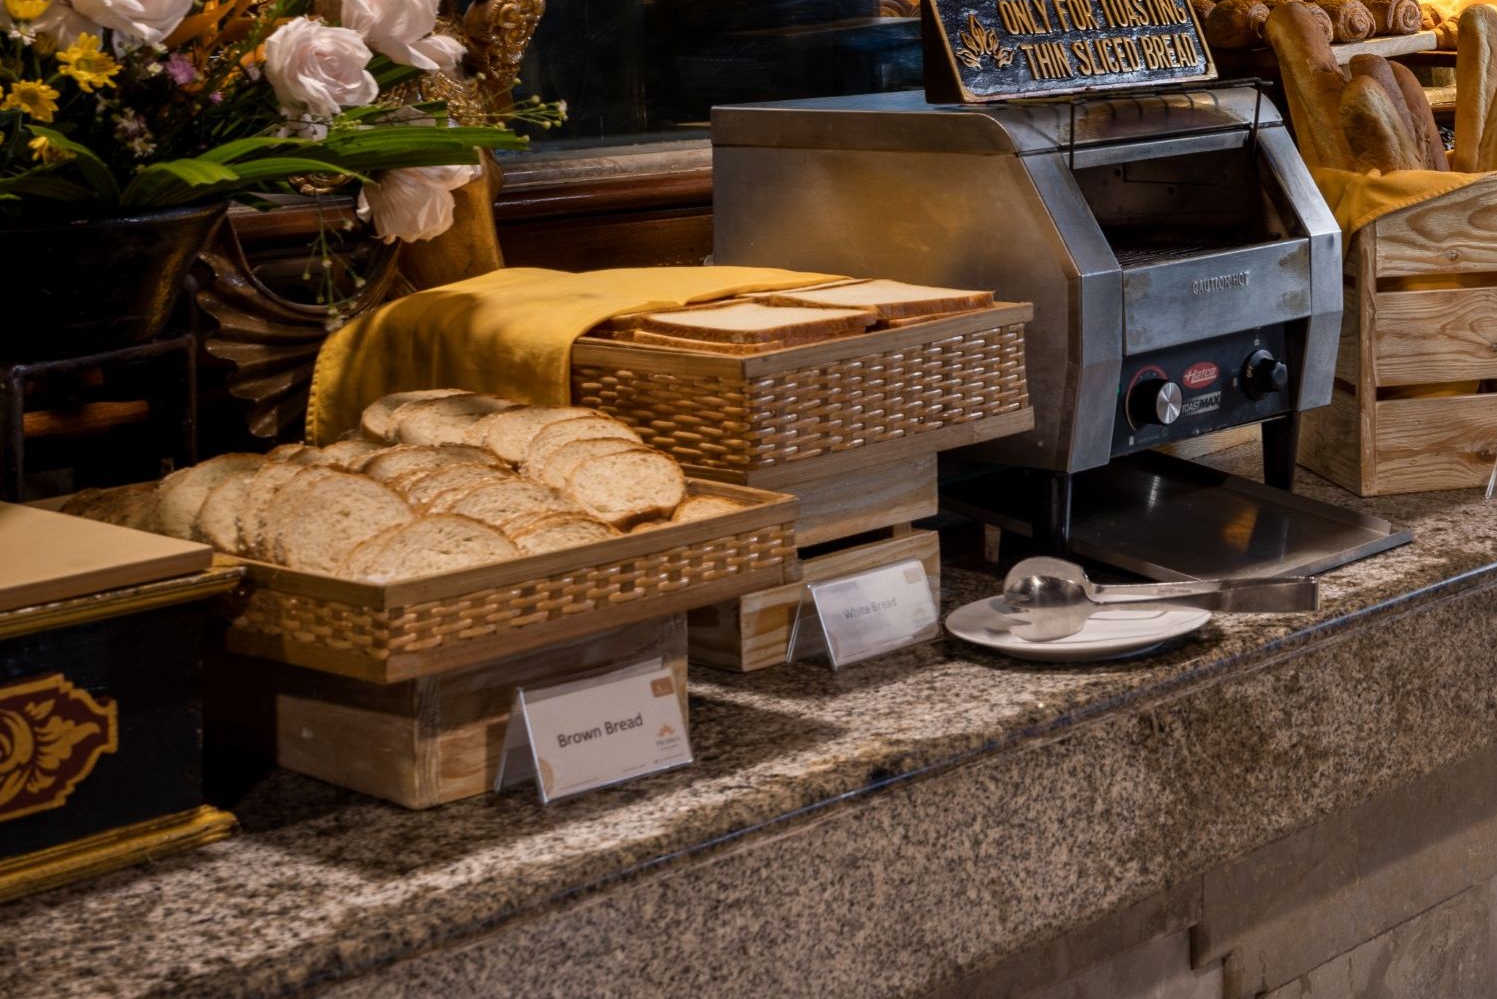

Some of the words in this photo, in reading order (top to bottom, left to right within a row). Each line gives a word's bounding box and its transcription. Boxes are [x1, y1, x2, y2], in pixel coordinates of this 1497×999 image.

[1019, 42, 1073, 80] THIN
[1071, 36, 1141, 76] SLICED
[1140, 33, 1199, 70] BREAD
[1192, 274, 1231, 296] CAUTION
[1231, 270, 1250, 288] HOT
[1184, 367, 1217, 381] Hatco
[556, 726, 602, 748] Brown
[604, 713, 643, 736] Bread
